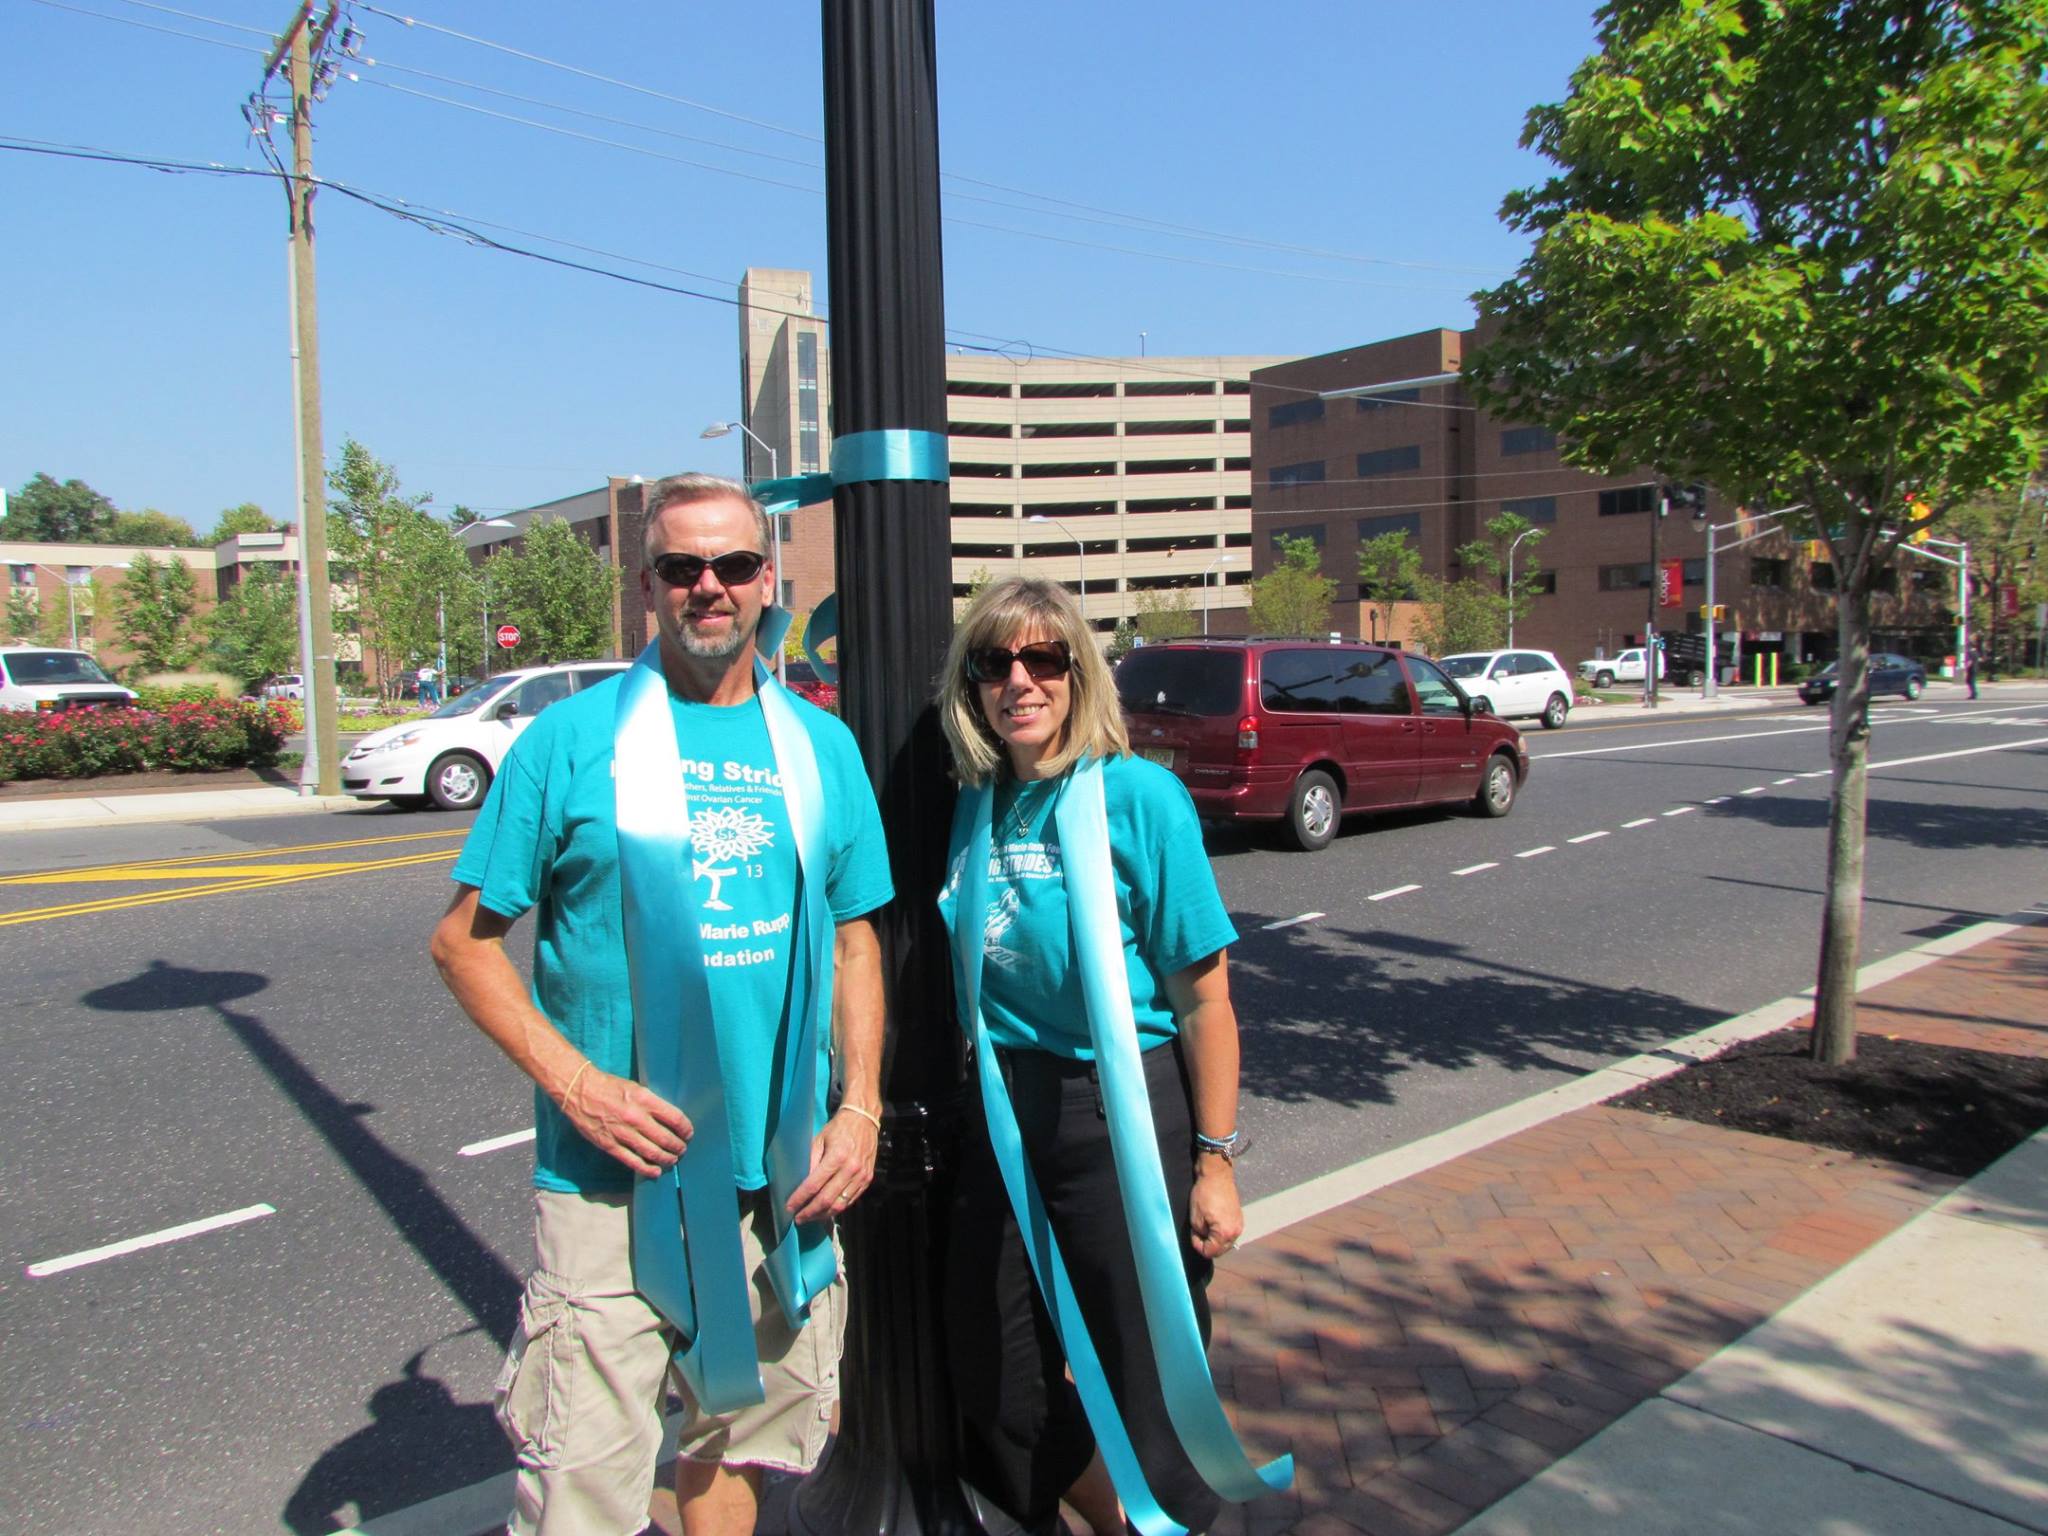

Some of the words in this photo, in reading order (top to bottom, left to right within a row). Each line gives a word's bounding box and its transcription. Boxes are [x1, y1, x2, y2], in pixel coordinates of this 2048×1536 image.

[1660, 569, 1671, 605] Cooper
[499, 632, 519, 642] STOP
[723, 761, 784, 788] Strid
[709, 784, 745, 793] Relatives
[746, 785, 754, 793] &
[701, 795, 733, 803] Ovarian
[734, 796, 763, 804] Cancer
[746, 864, 763, 878] 13
[700, 923, 749, 939] Marie
[752, 912, 790, 936] Rupp
[704, 949, 775, 967] dation
